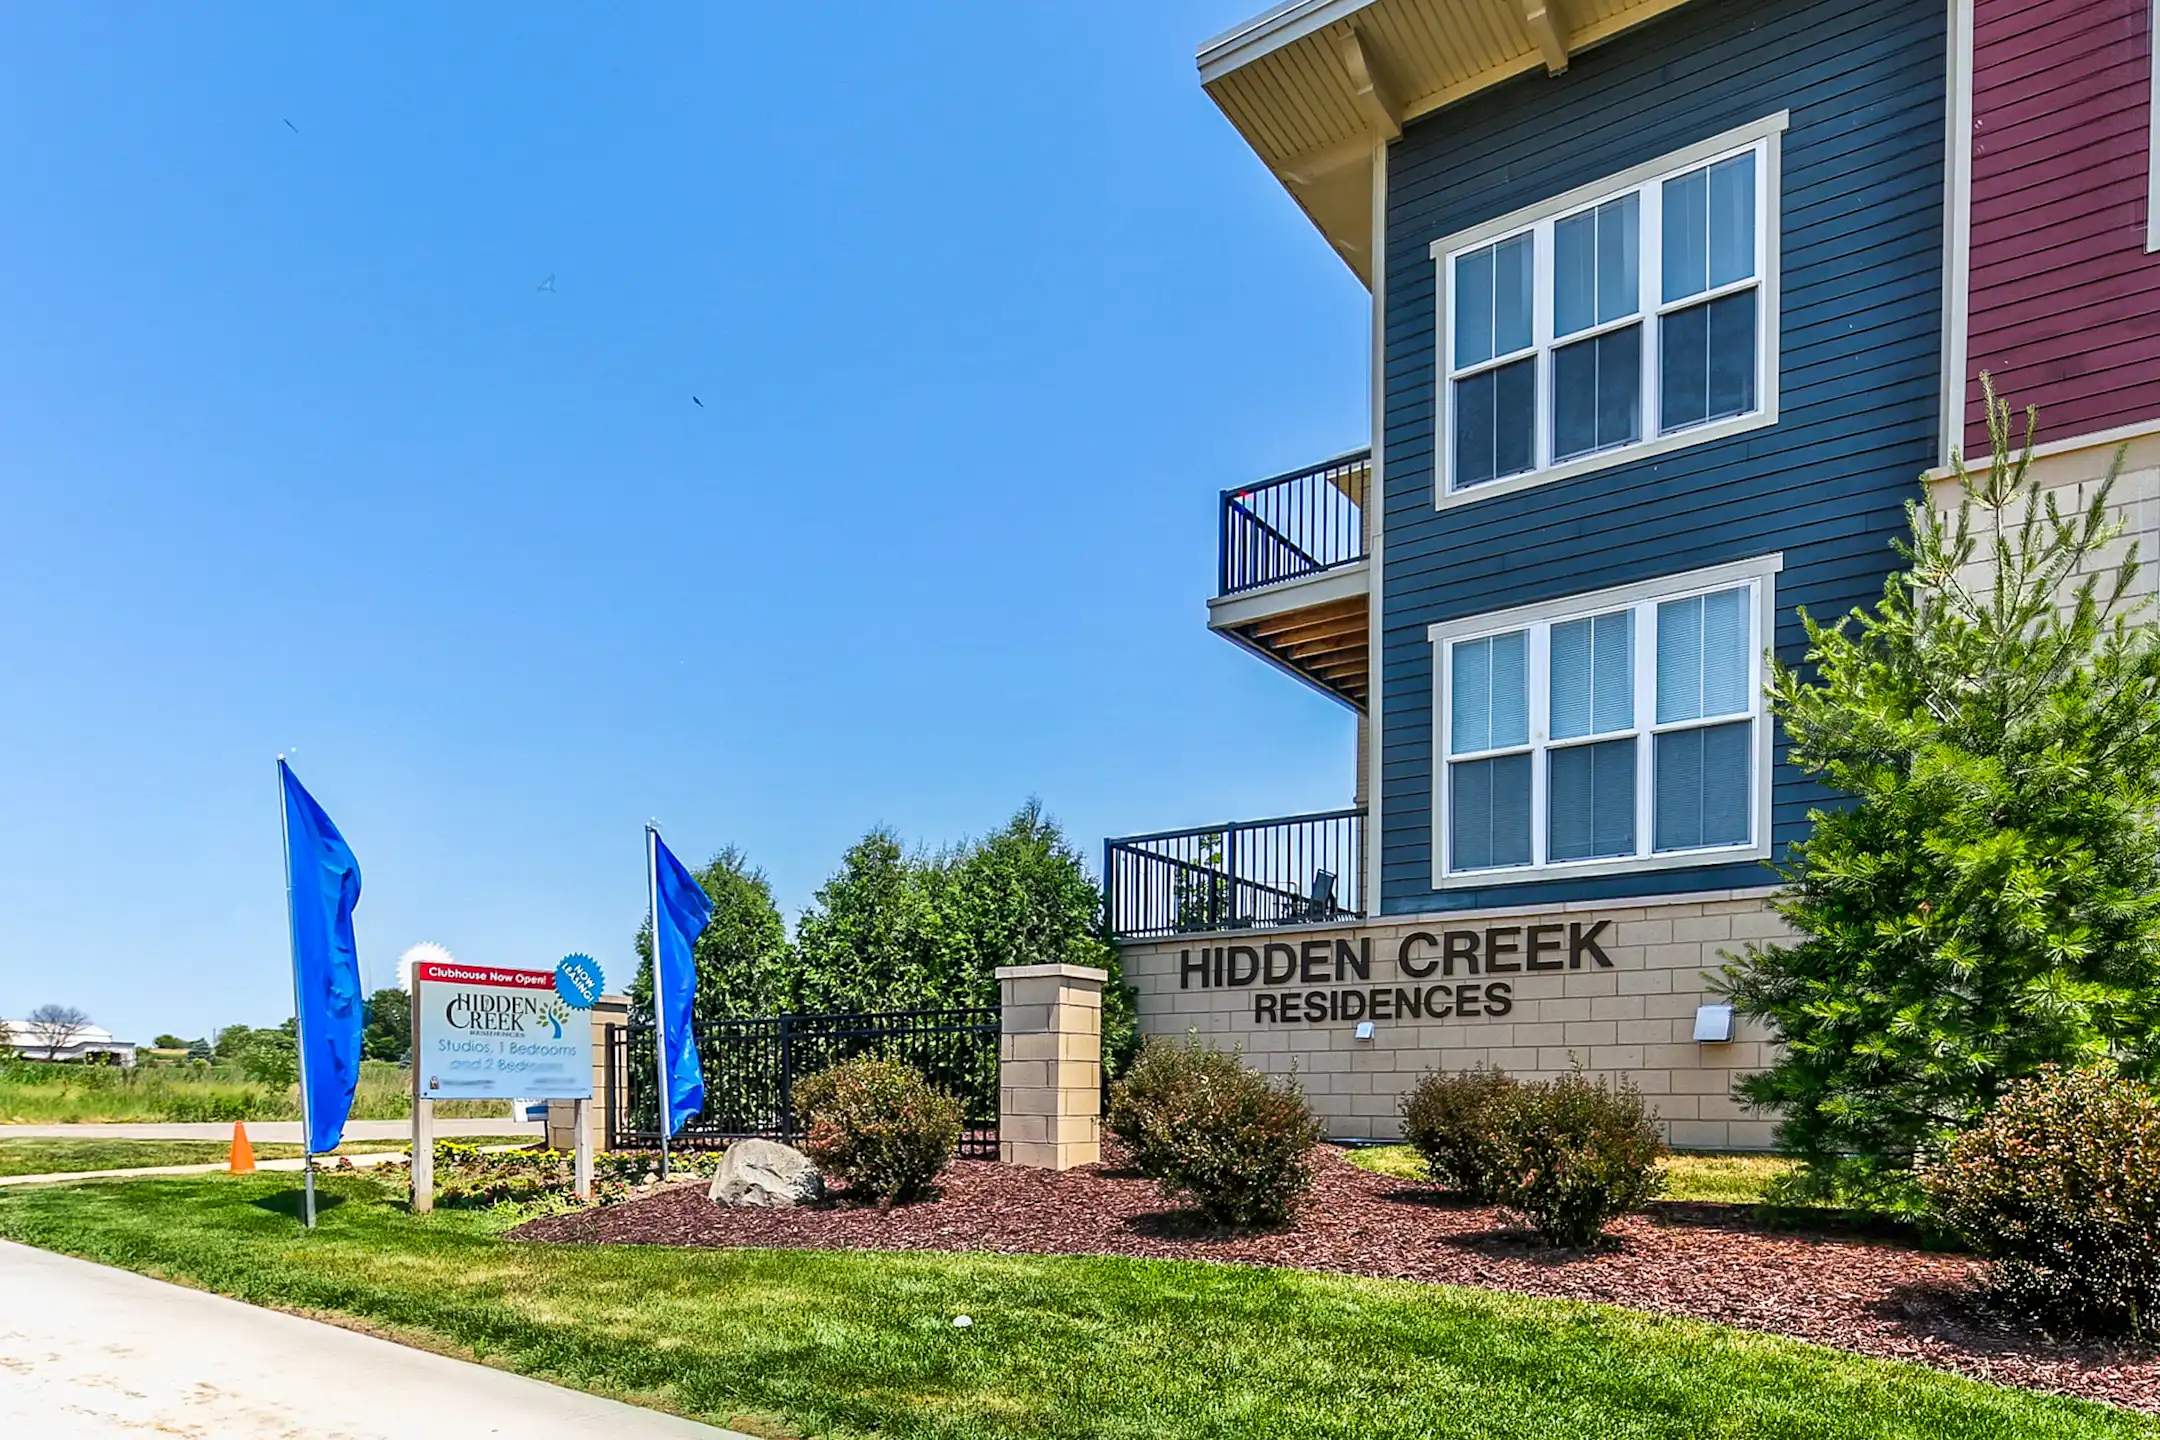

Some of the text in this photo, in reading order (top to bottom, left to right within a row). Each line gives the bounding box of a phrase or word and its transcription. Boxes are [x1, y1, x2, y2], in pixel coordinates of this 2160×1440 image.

[1181, 920, 1614, 989] HIDDEN CREEK
[429, 966, 547, 985] Clubhouse Now Open!
[561, 962, 594, 1003] LEASING!
[574, 964, 595, 988] NOW
[446, 998, 525, 1031] CREEK
[456, 993, 537, 1014] HIDDEN
[1254, 982, 1513, 1023] RESIDENCES
[438, 1039, 494, 1055] Studios,
[510, 1041, 577, 1056] Bedrooms
[450, 1058, 482, 1070] and
[485, 1059, 494, 1070] 2
